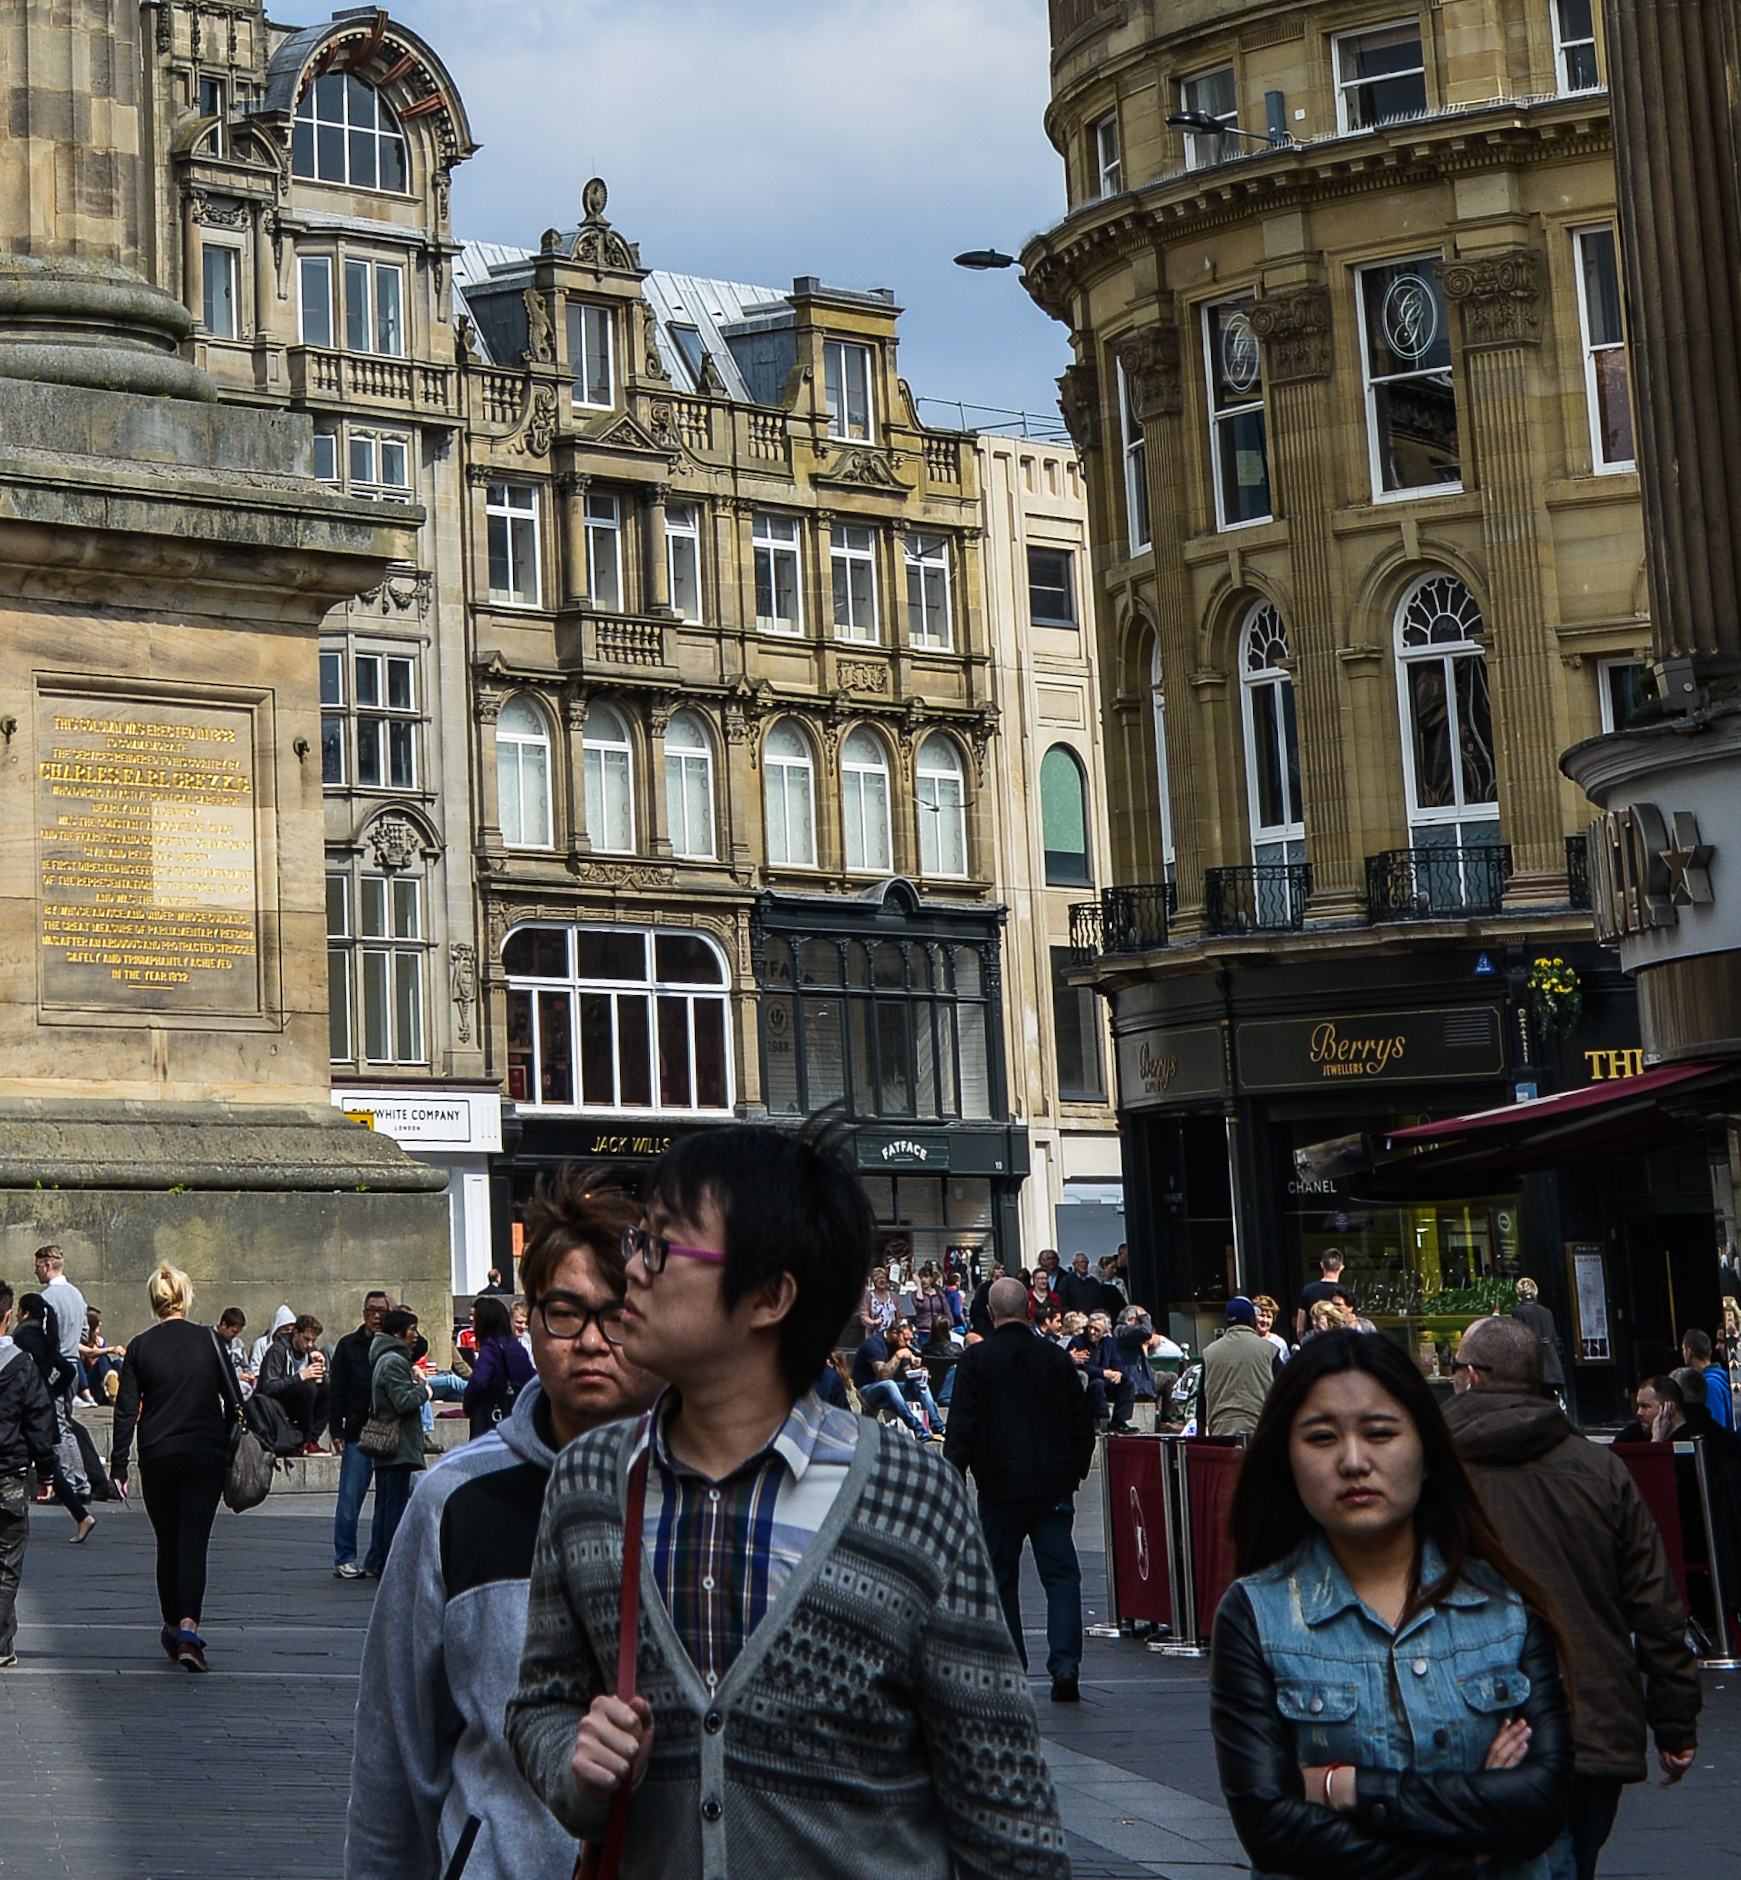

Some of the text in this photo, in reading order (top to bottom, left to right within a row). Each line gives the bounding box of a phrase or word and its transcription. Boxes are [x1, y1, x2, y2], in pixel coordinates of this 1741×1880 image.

[53, 716, 78, 731] THIS
[79, 717, 122, 734] COLUMN
[124, 720, 146, 736] WAS
[146, 723, 196, 740] ERECTED
[197, 726, 209, 741] IN
[105, 737, 188, 753] TO COMMEMORATE
[52, 747, 71, 759] THE
[160, 755, 171, 766] TO
[172, 756, 187, 768] HIS
[123, 766, 170, 788] EARL
[105, 788, 117, 799] AN
[58, 815, 77, 826] WAS
[78, 815, 96, 827] THE
[40, 828, 58, 840] AND
[58, 829, 74, 841] THE
[122, 834, 140, 844] AND
[108, 848, 127, 859] AND
[51, 860, 76, 871] FIRST
[42, 874, 55, 885] OF
[58, 875, 75, 886] THE
[95, 892, 114, 903] AND
[116, 893, 136, 904] WAS
[44, 904, 57, 915] BY
[125, 909, 145, 919] AND
[146, 910, 174, 921] UNDER
[43, 920, 60, 930] THE
[61, 921, 90, 931] GREAT
[92, 922, 133, 934] MEASURE
[135, 924, 146, 935] OF
[88, 937, 101, 948] AN
[143, 940, 160, 950] AND
[161, 940, 215, 953] PROTRACTED
[66, 951, 233, 969] SAFELY AND TRIUMPHANTLY ACHIEVED
[111, 968, 121, 979] IN
[123, 969, 141, 980] THE
[144, 970, 168, 981] YEAR
[1309, 1022, 1406, 1075] Berrys
[1322, 1062, 1364, 1076] JEWELLERS
[374, 1109, 461, 1121] WHITE COMPANY
[591, 1136, 671, 1154] JACK WILLS
[881, 1140, 928, 1161] FATFACE
[1288, 1179, 1338, 1194] CHANEL
